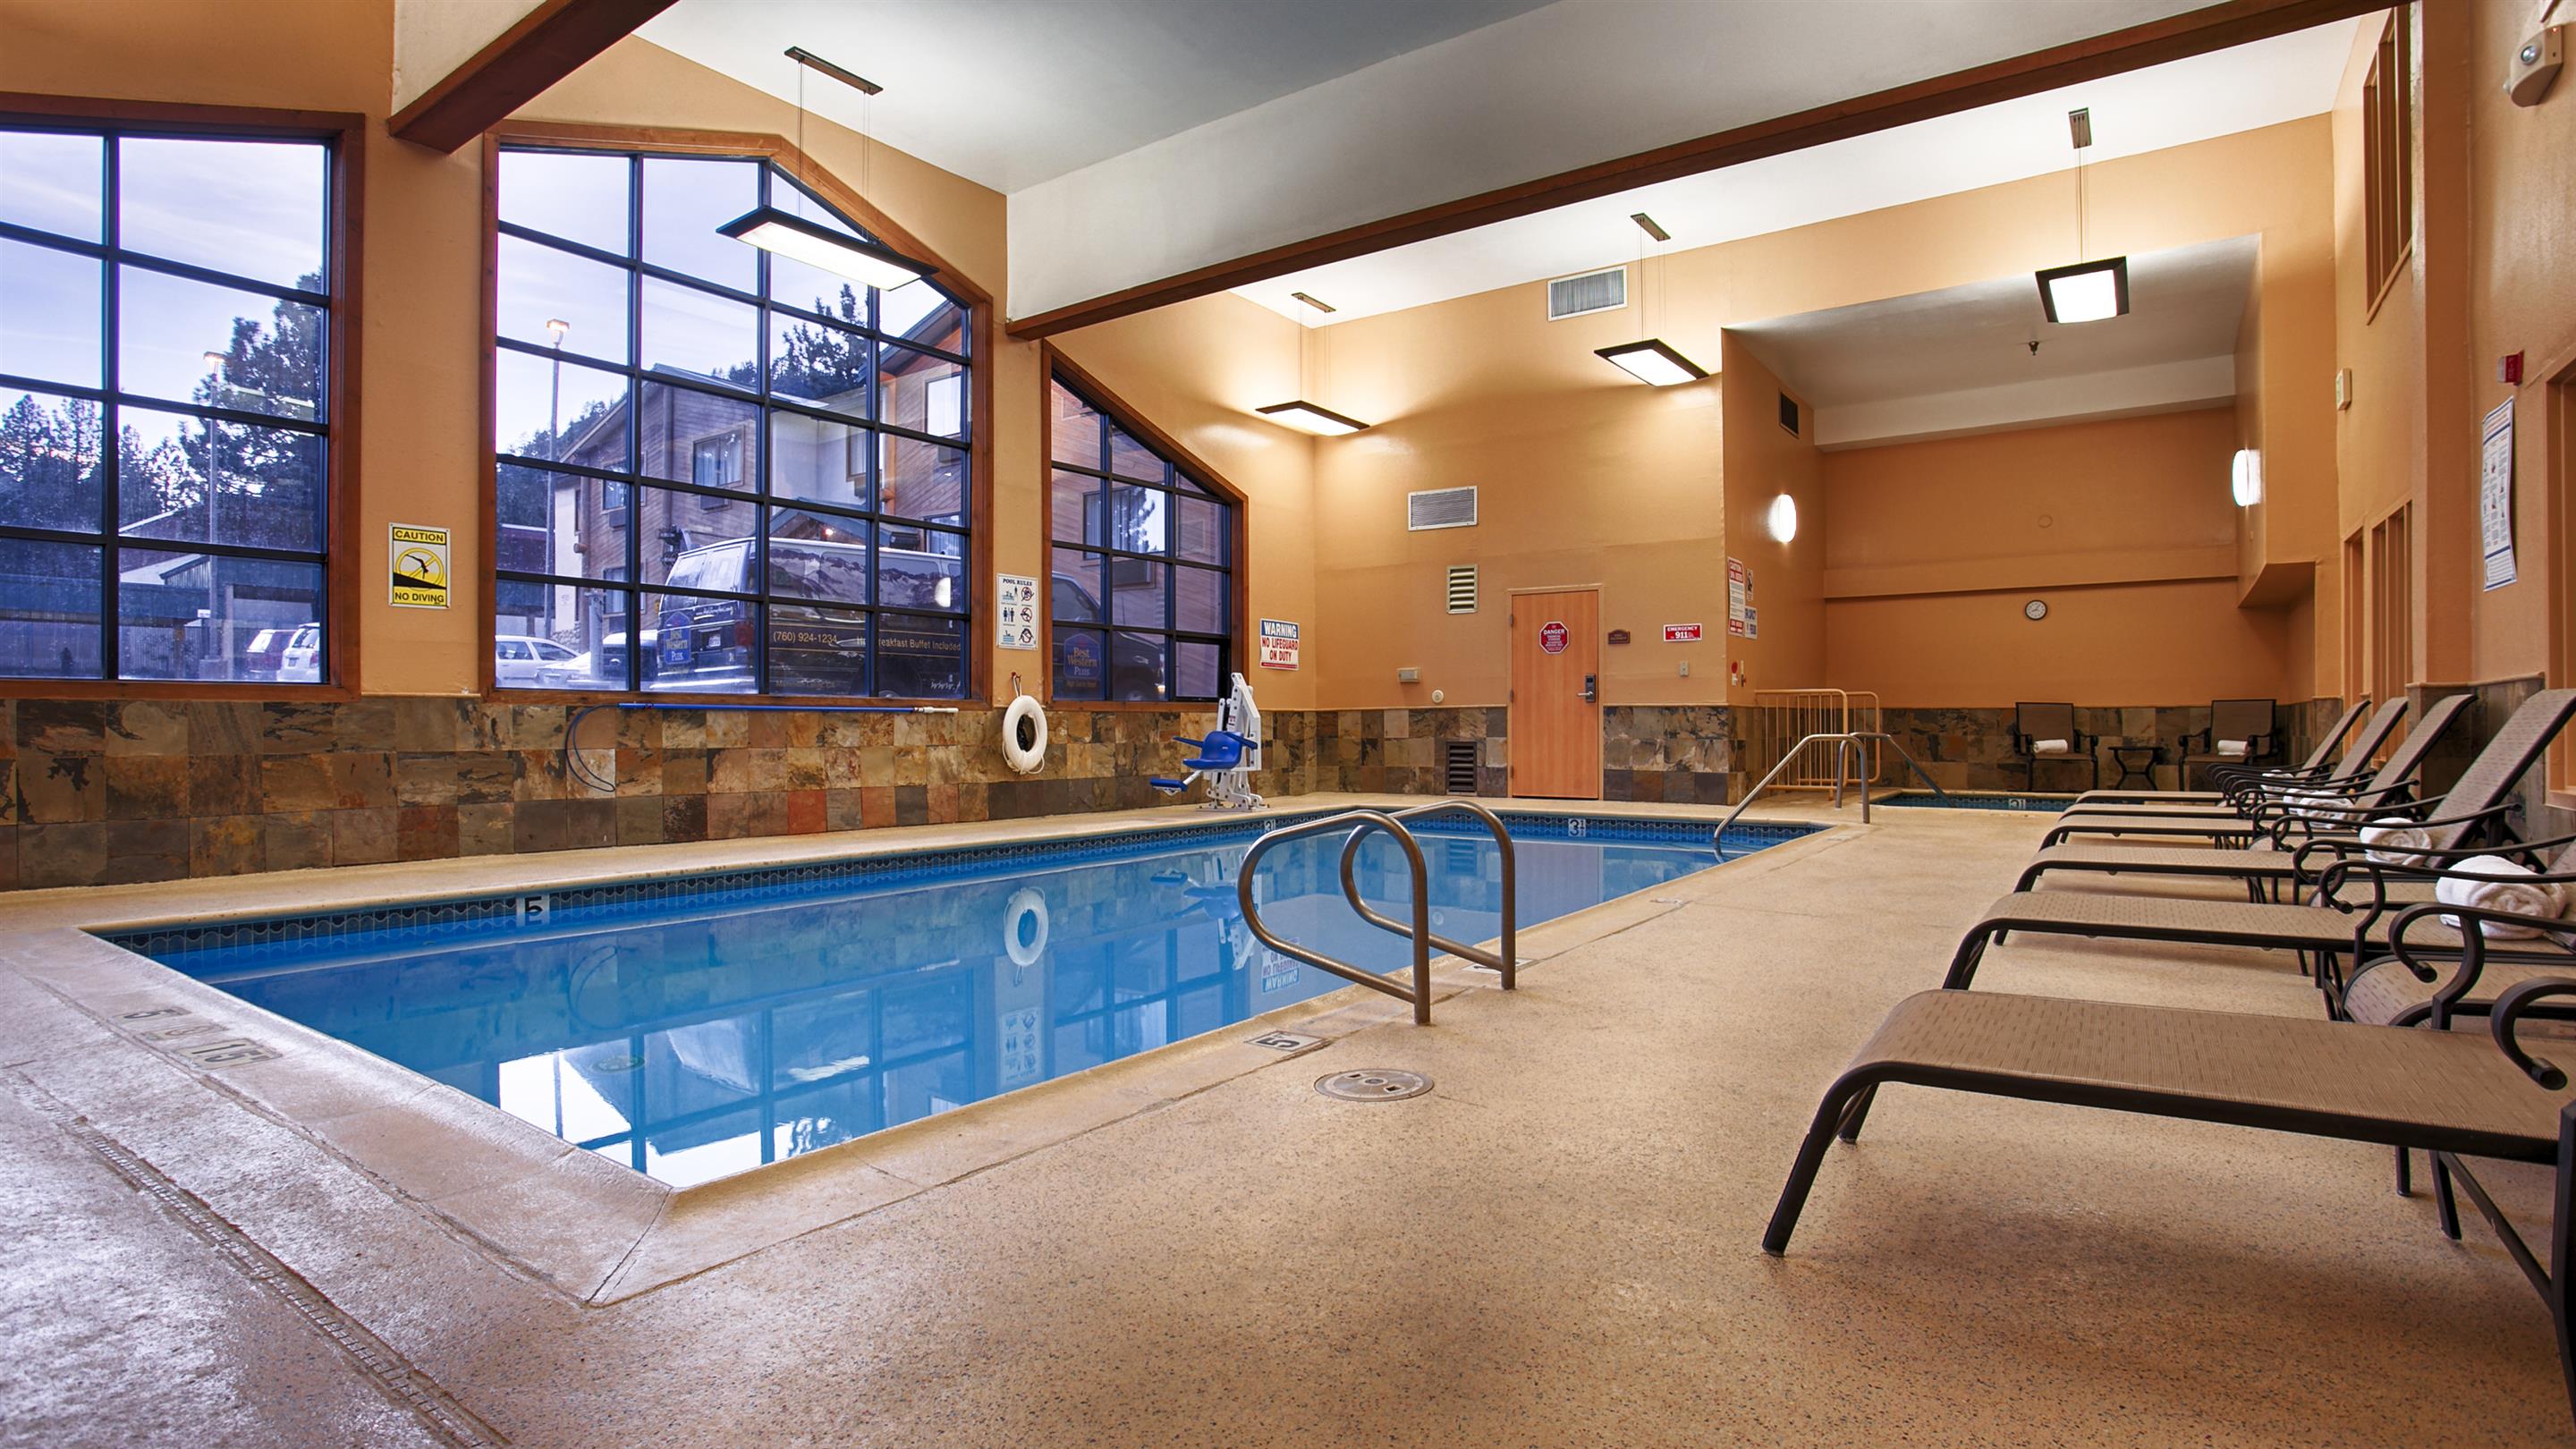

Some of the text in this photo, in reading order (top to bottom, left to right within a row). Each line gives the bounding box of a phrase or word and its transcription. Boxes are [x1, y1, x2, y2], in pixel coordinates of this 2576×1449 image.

[395, 530, 444, 542] CAUTION
[394, 592, 445, 603] NO DIVING
[1263, 622, 1297, 639] WARNING
[1674, 631, 1689, 639] 911
[773, 631, 796, 643] (760)
[798, 632, 837, 644] 924-1234
[878, 638, 909, 648] reakfast
[910, 639, 931, 649] Buffet
[932, 640, 962, 651] Included
[1262, 637, 1298, 650] NO LIFEGUARD
[1073, 647, 1089, 658] Best
[1270, 649, 1292, 662] ON DUTY
[1067, 655, 1098, 667] Western
[524, 895, 544, 919] 5
[1256, 1037, 1301, 1048] 5
